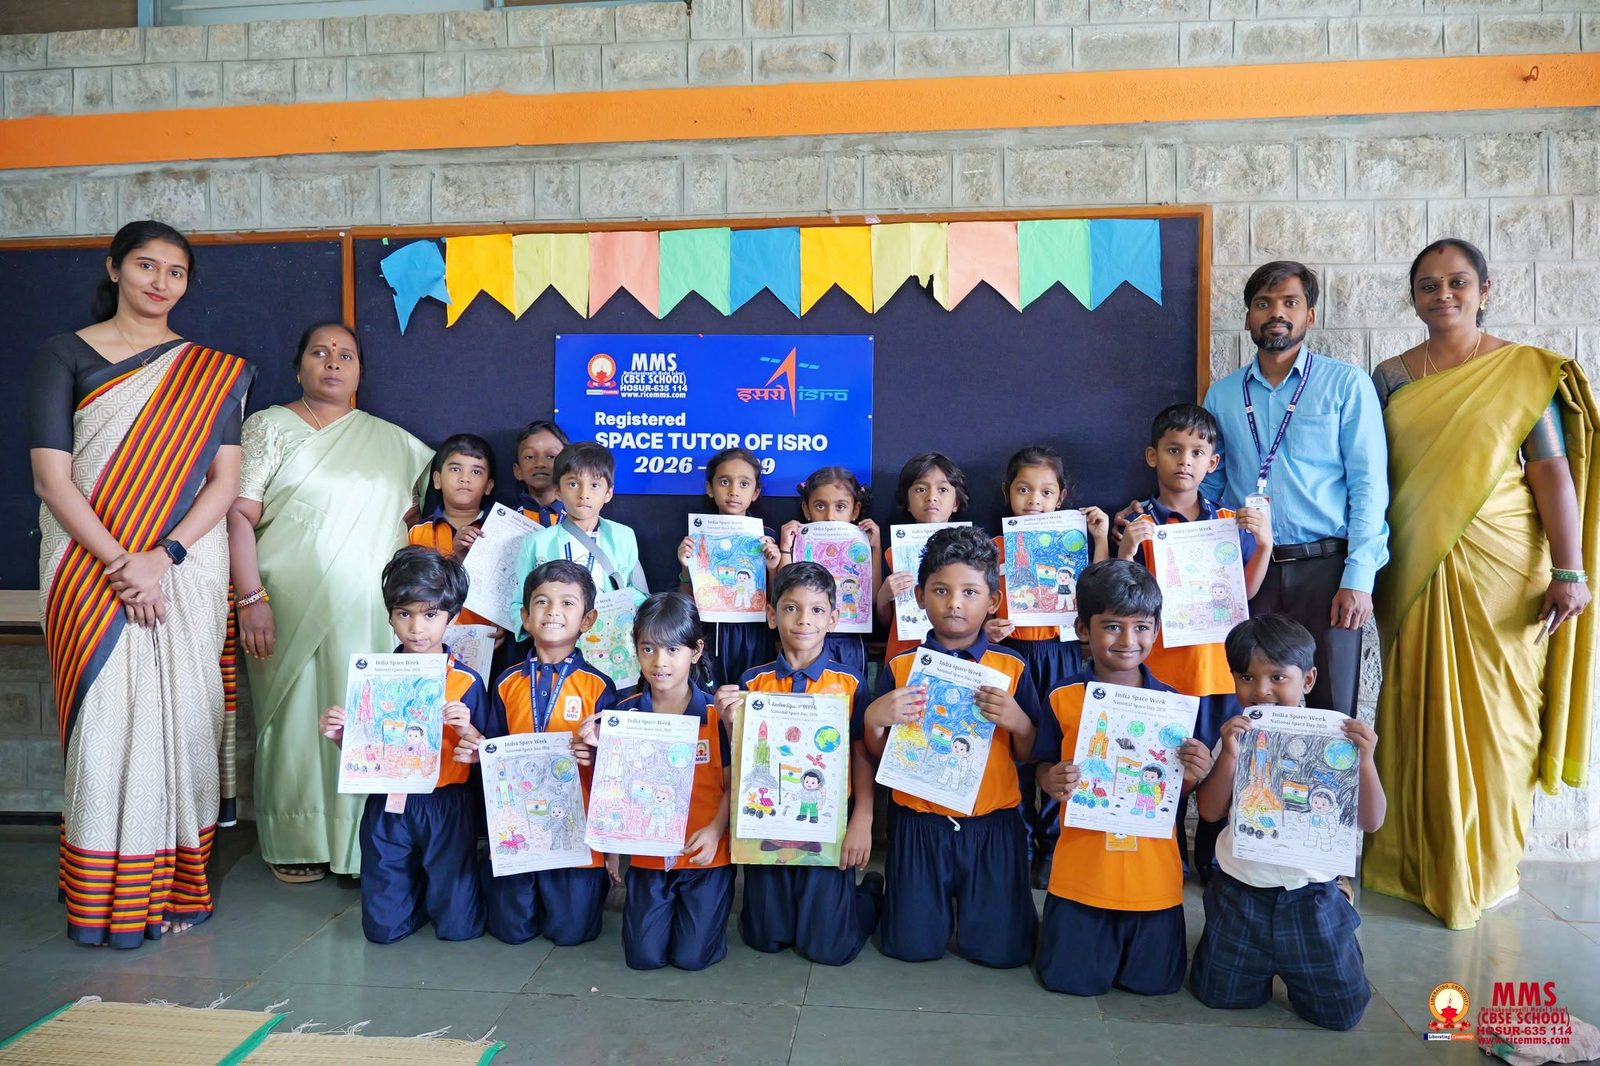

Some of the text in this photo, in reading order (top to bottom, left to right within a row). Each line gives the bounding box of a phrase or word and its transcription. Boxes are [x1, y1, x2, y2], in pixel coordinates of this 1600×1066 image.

[631, 353, 677, 372] MMS
[620, 384, 688, 392] HOSUR-635 114
[621, 374, 687, 385] (CBSE SCHOOL)
[736, 384, 786, 403] इसरो
[797, 386, 848, 401] isro
[595, 412, 686, 429] Registered
[595, 432, 828, 451] SPACE TUTOR OF ISRO
[633, 456, 693, 474] 2026
[938, 660, 982, 677] India Space Week
[1114, 691, 1166, 705] India Space Week
[1289, 712, 1308, 720] Space
